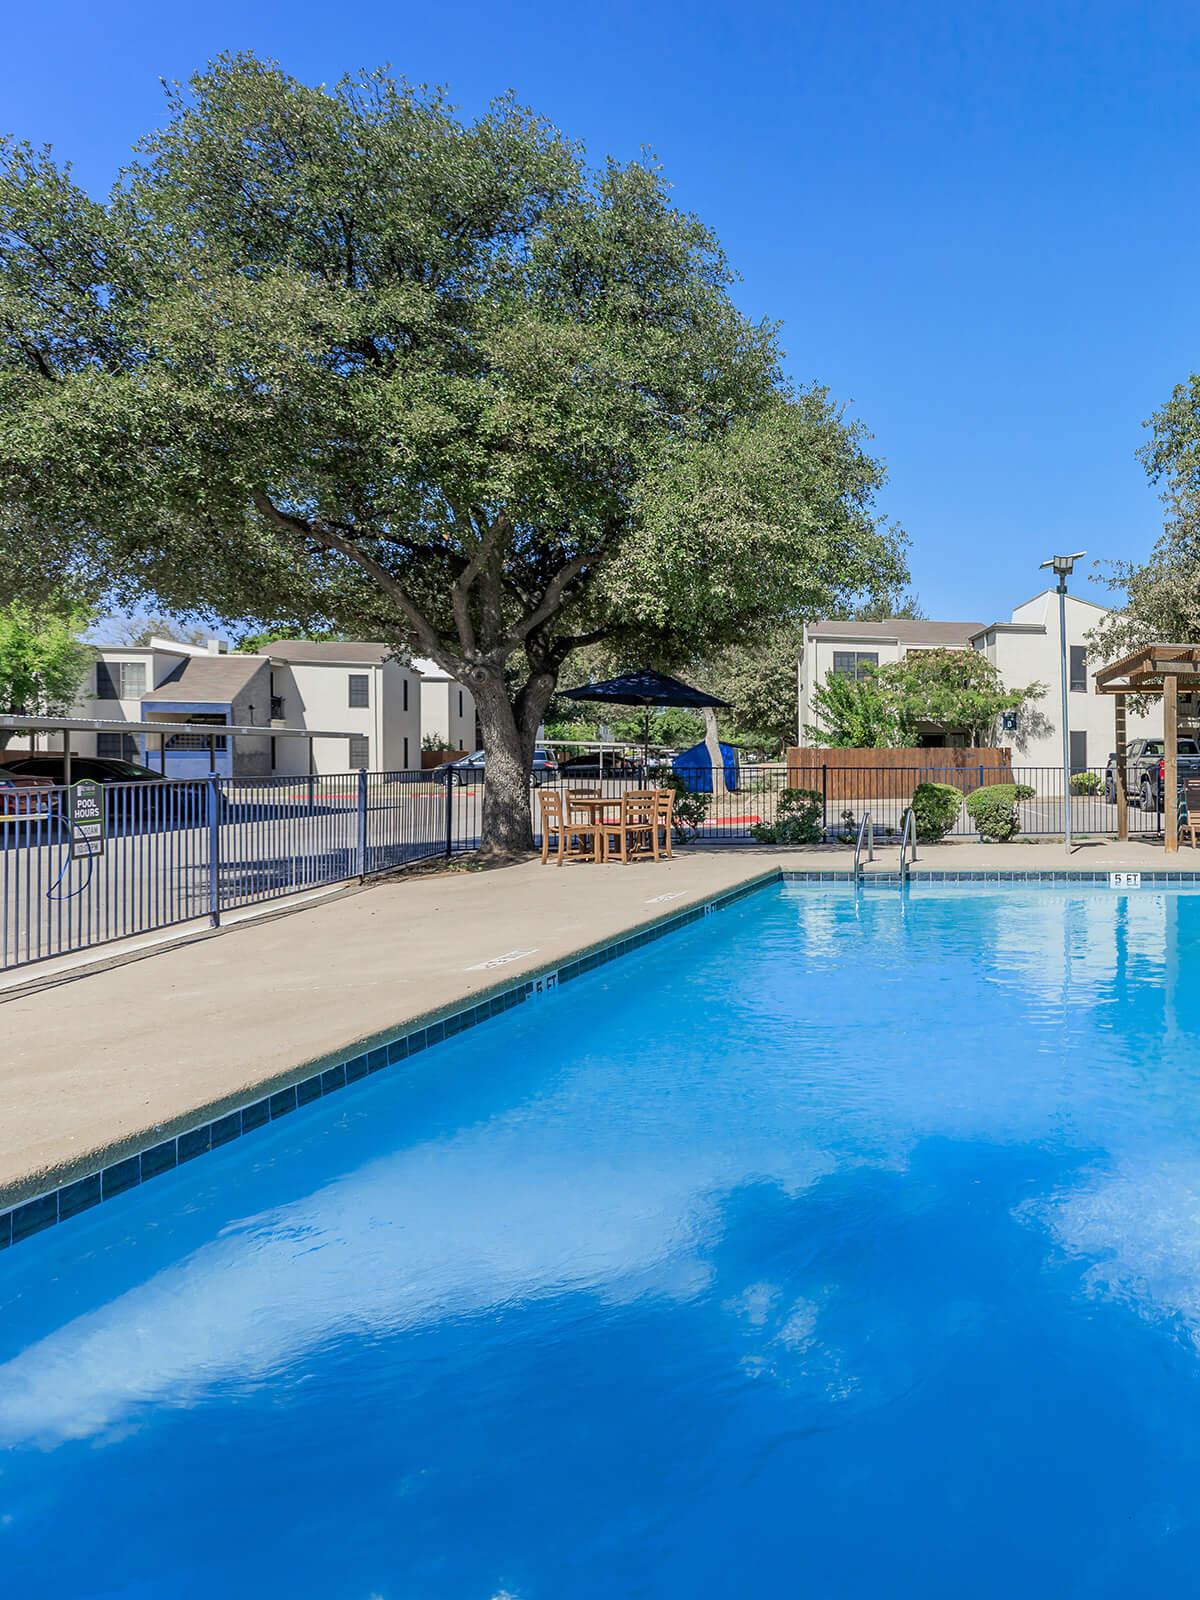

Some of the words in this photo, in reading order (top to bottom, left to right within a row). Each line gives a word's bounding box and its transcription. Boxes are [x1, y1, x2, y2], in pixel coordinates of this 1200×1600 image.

[77, 799, 96, 808] POOL
[74, 808, 100, 818] HOURS
[1115, 874, 1121, 885] 5
[1127, 874, 1138, 885] FT
[546, 975, 556, 990] FT
